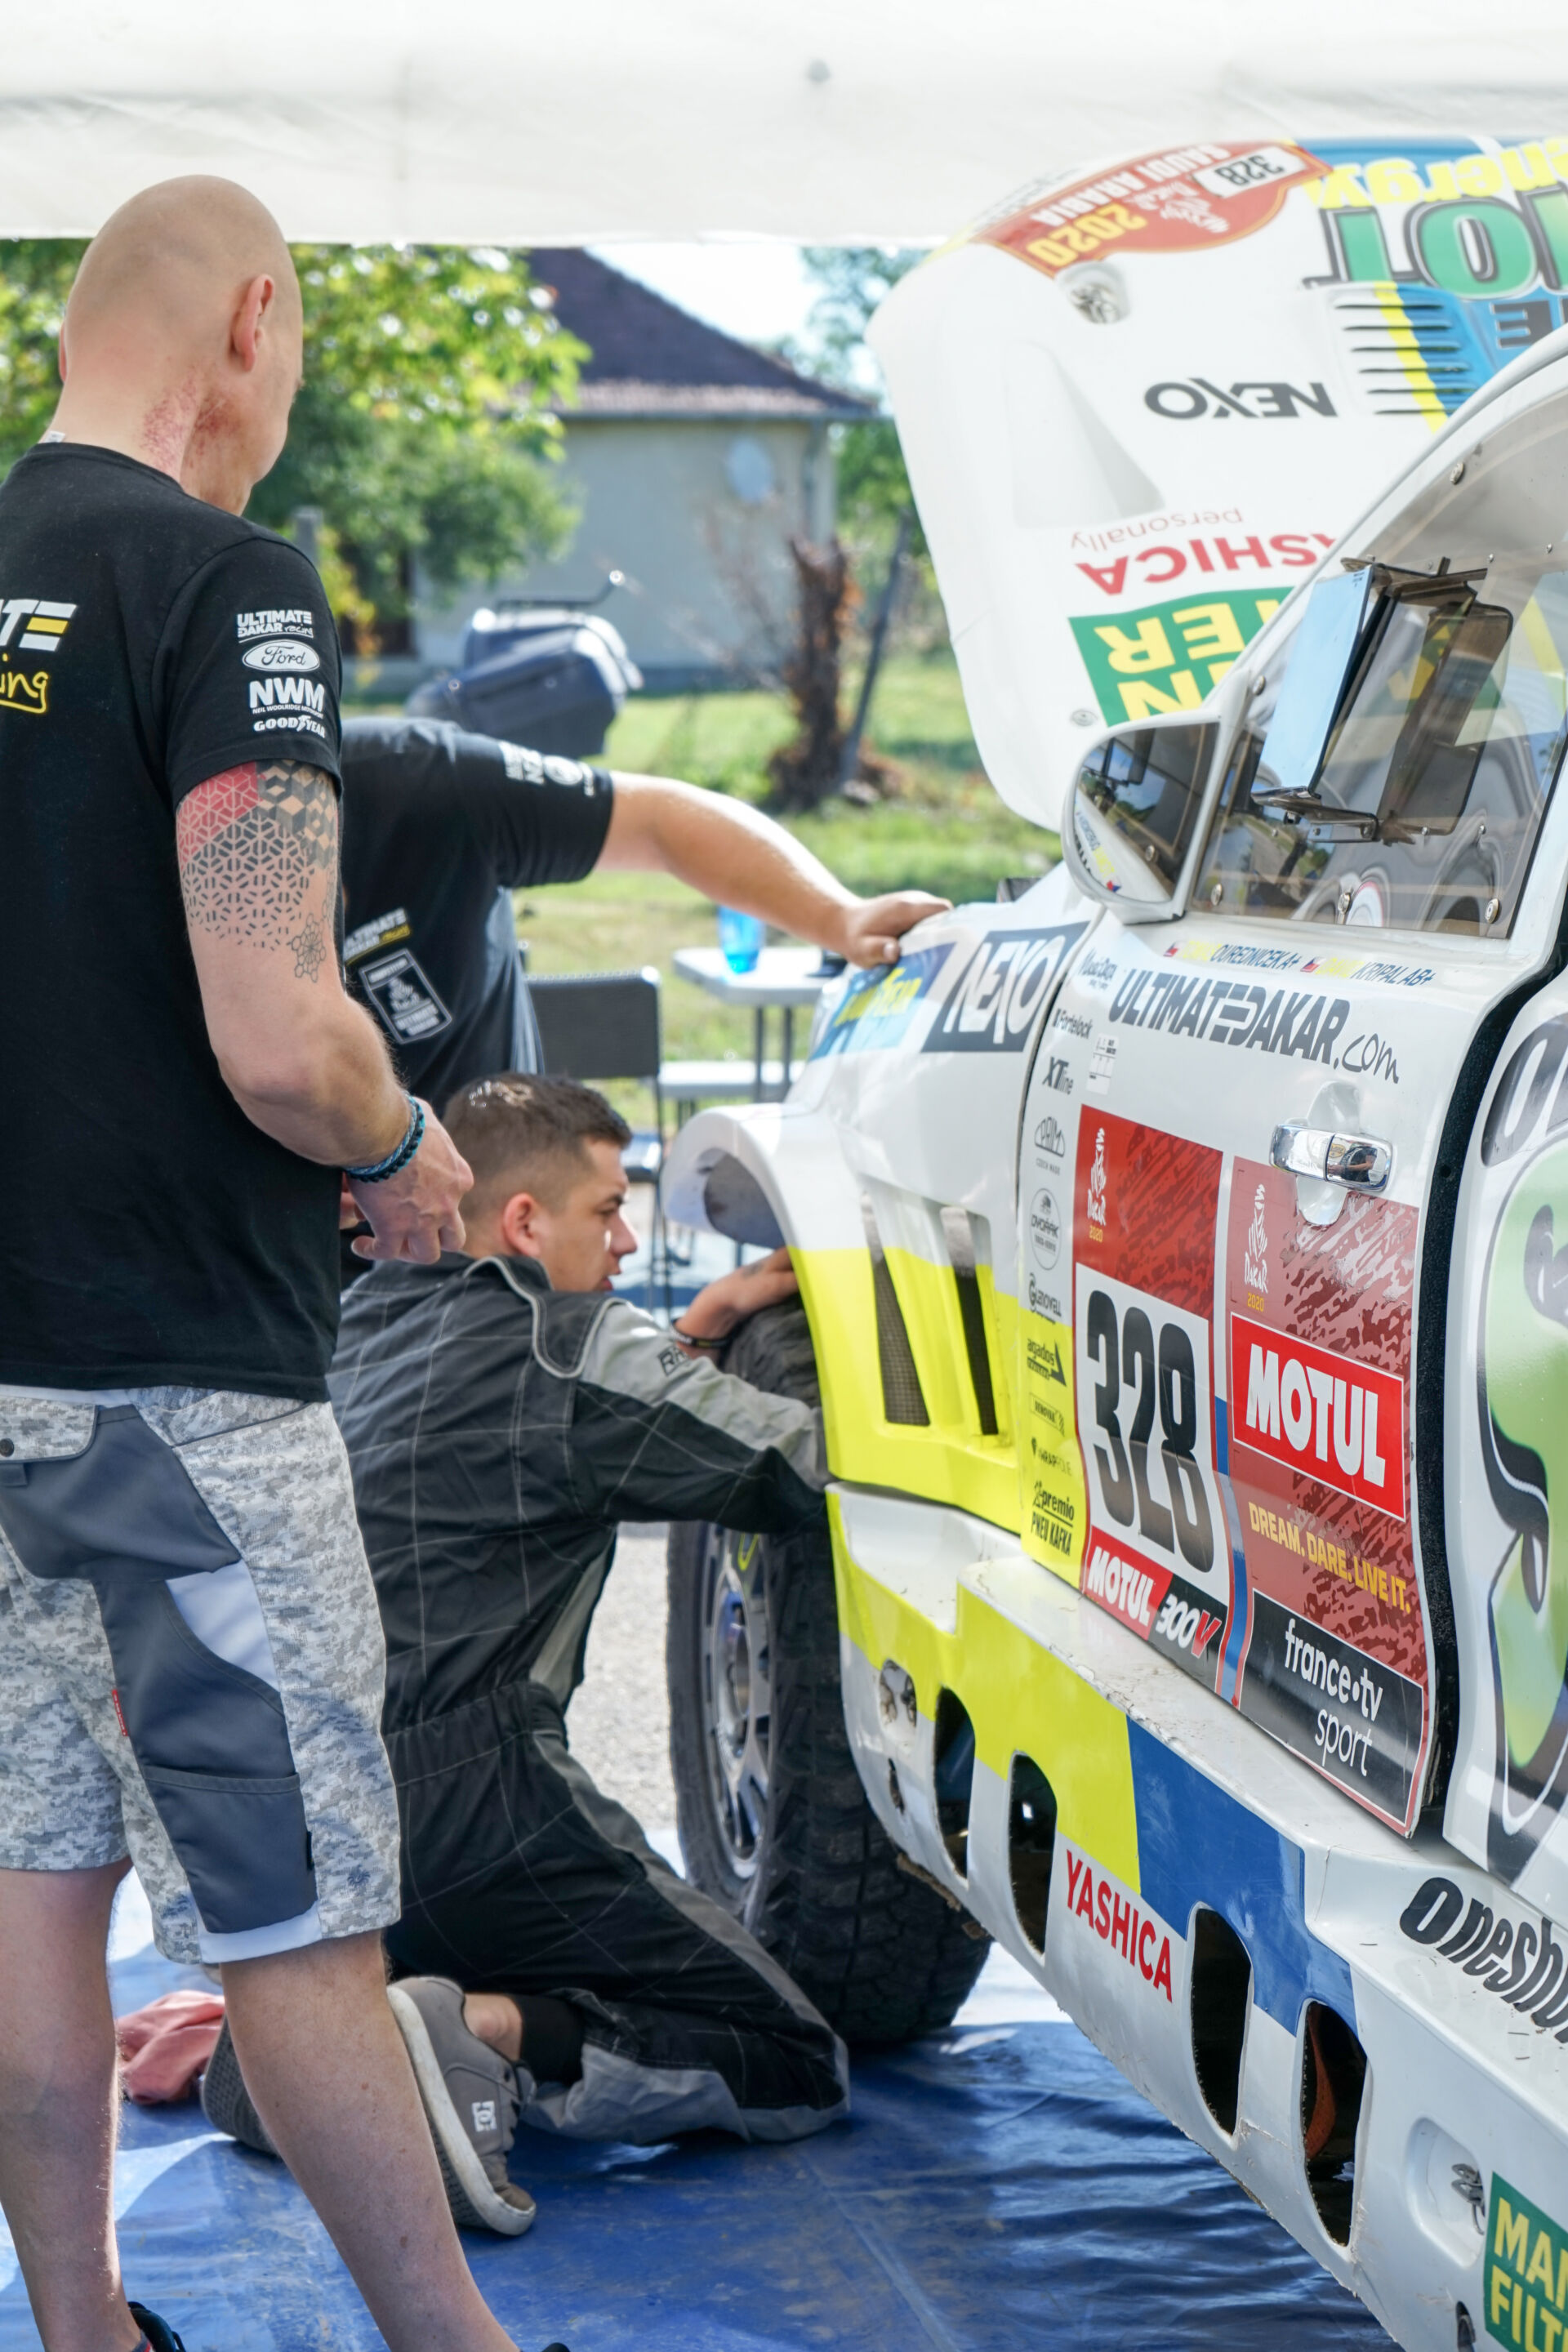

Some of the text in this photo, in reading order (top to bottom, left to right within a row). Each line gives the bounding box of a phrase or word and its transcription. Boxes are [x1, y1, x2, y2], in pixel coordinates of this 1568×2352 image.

[1214, 154, 1285, 187] 328
[1027, 203, 1148, 266] 2020
[1144, 378, 1339, 419] NEXO
[1071, 507, 1244, 552] personally
[237, 609, 312, 627] ULTIMATE
[238, 622, 283, 638] DAKAR
[261, 645, 307, 666] Ford
[249, 677, 325, 712] NWM
[253, 715, 326, 738] GOODYEAR
[942, 935, 1066, 1045] NEXO
[1089, 1225, 1103, 1243] 2020
[1247, 1292, 1264, 1312] 2020
[1087, 1290, 1214, 1573] 328
[1245, 1343, 1386, 1489] MOTUL
[1041, 1490, 1075, 1521] premio
[1031, 1511, 1072, 1557] PNEU KAFKA
[1248, 1502, 1411, 1614] DREAM. DARE. LIVE IT.
[1087, 1546, 1223, 1659] MOTUL 300V
[1315, 1709, 1373, 1777] sport
[1067, 1849, 1173, 2003] YASHICA
[1490, 2265, 1568, 2352] FILT
